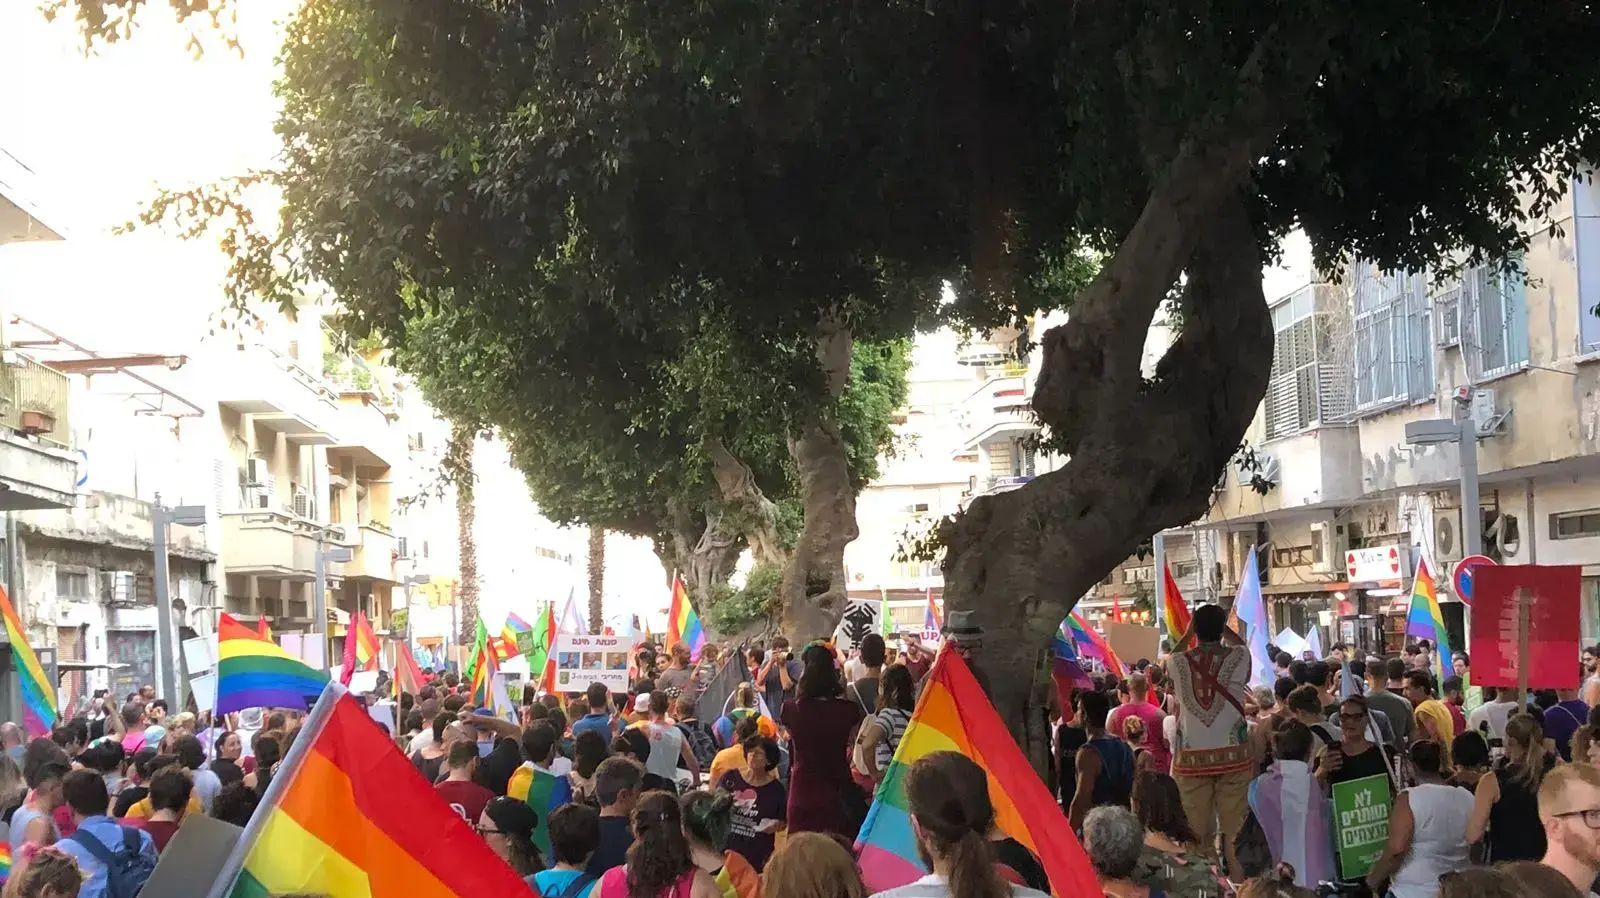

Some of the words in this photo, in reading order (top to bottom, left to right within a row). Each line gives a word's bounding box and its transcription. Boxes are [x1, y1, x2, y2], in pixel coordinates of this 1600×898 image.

[1354, 788, 1371, 808] לא
[1341, 804, 1388, 826] מוותרים
[1345, 823, 1389, 846] מנצחים
